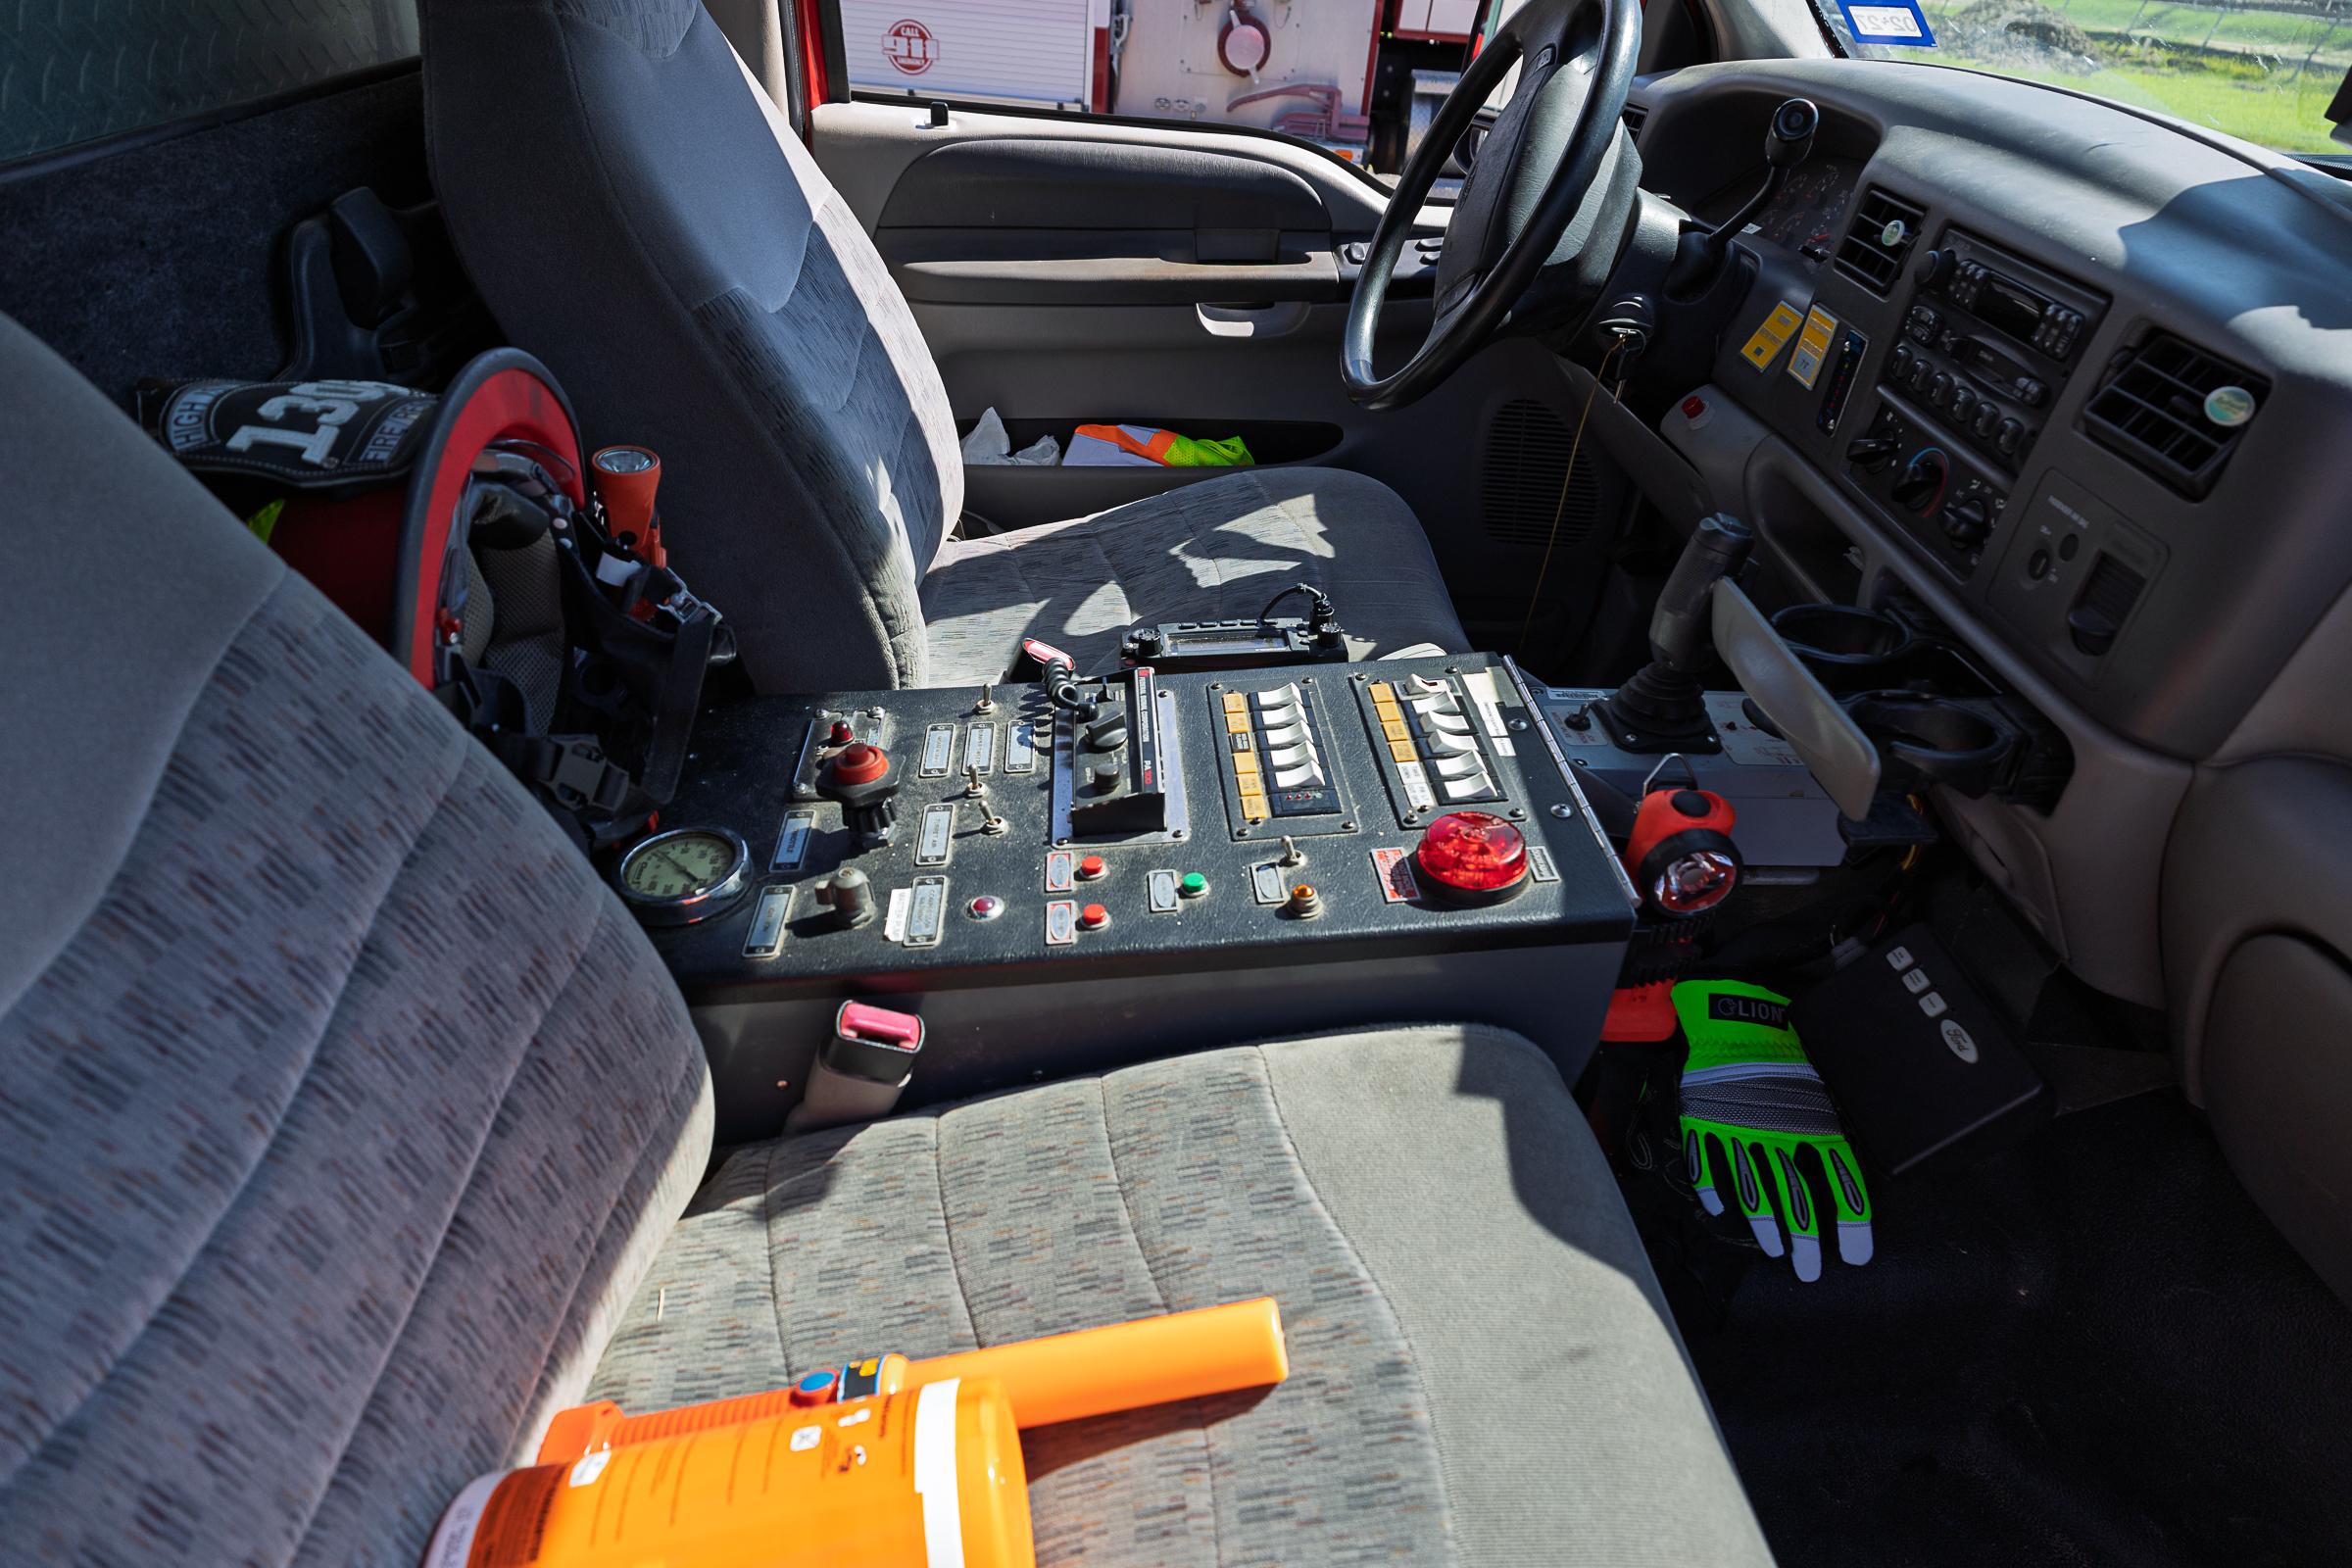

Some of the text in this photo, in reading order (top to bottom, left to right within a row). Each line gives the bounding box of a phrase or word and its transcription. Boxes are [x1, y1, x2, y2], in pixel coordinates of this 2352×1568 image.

[901, 26, 920, 37] CALL
[882, 34, 939, 60] 911
[173, 400, 206, 450] HIGH
[1738, 1002, 1784, 1024] LION
[1945, 1027, 1970, 1054] Ford
